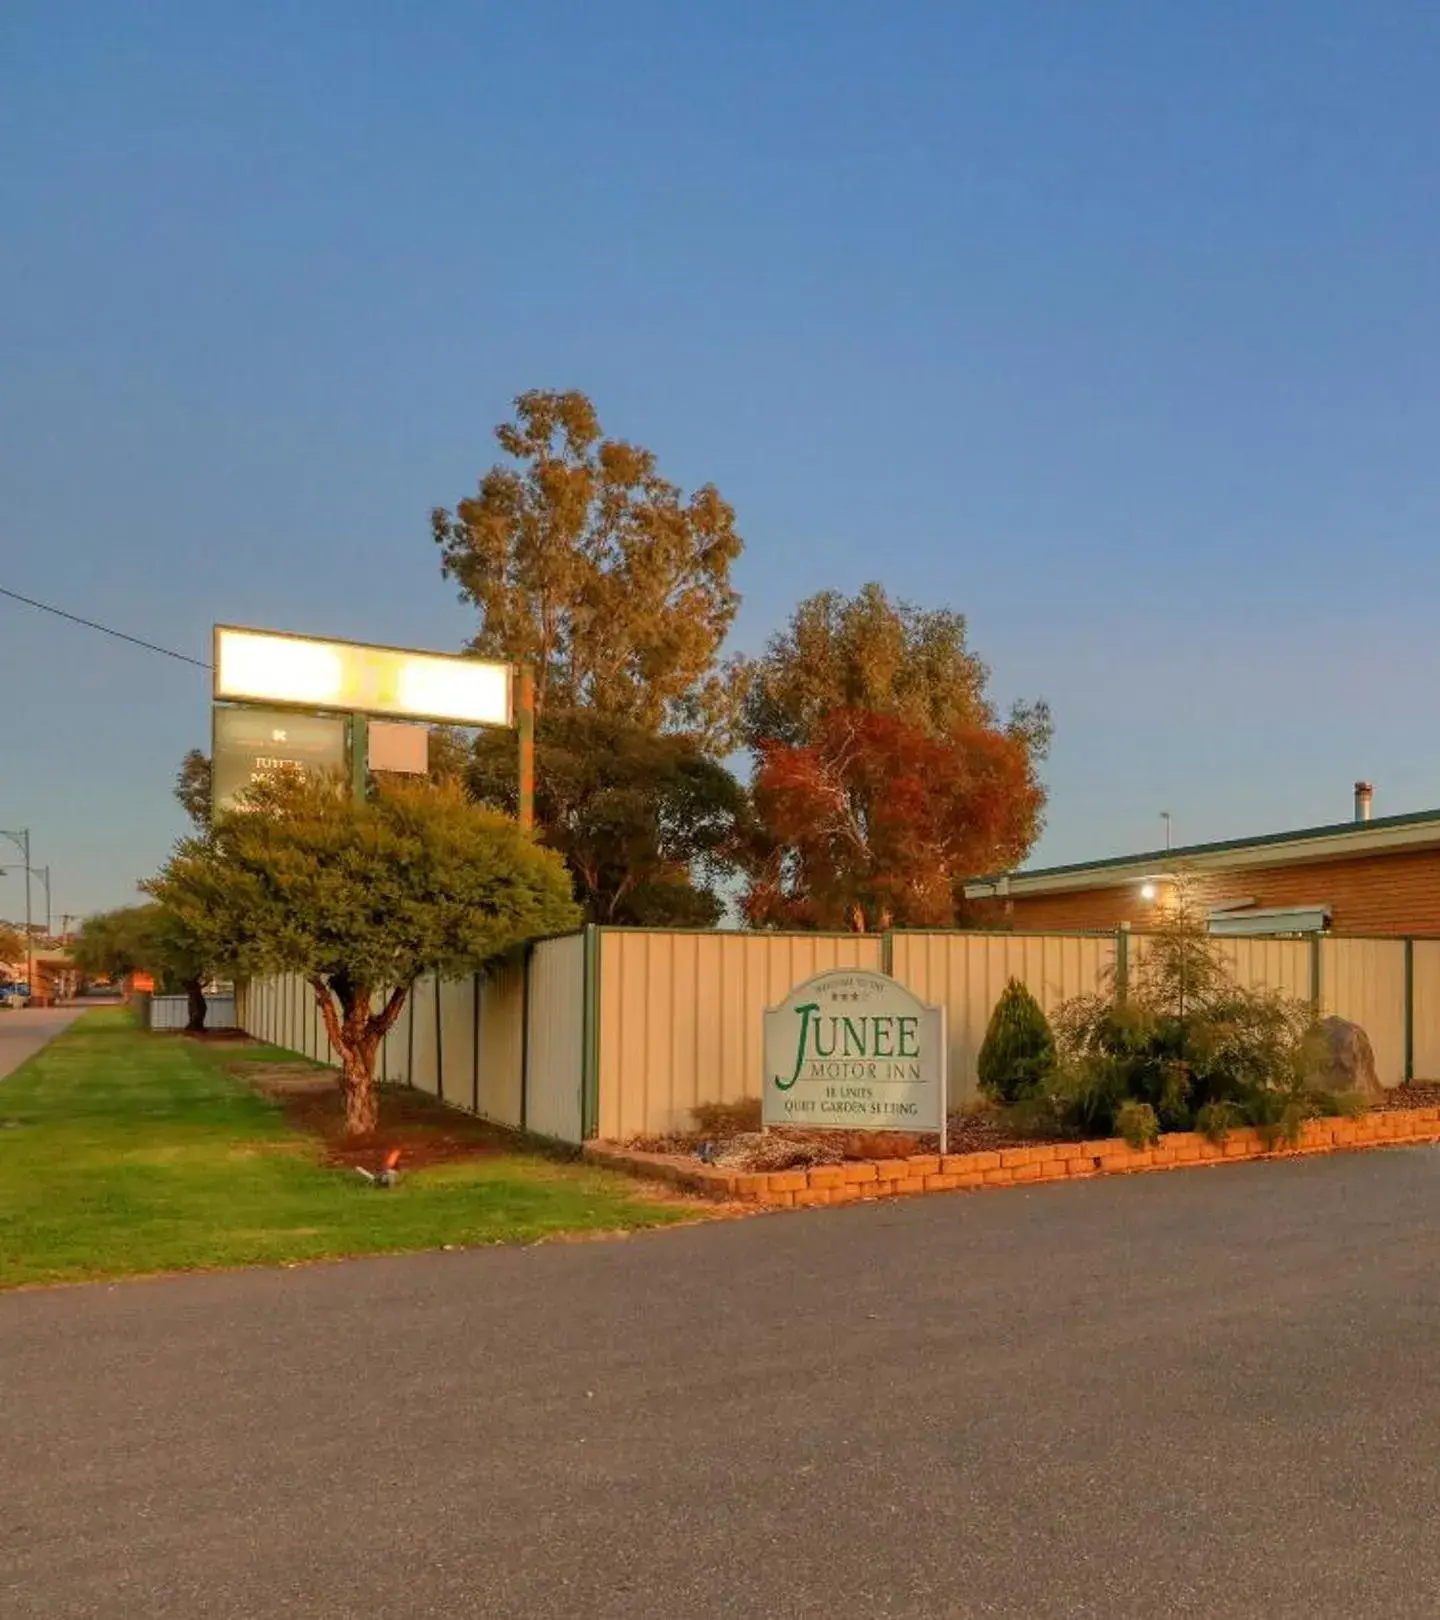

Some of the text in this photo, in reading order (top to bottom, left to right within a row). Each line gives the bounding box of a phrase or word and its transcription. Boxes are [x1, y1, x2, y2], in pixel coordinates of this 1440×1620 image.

[775, 1003, 920, 1090] JUNEE
[810, 1062, 921, 1080] MOTOR INN
[840, 1086, 873, 1098] UNITS
[784, 1099, 918, 1116] QUIET GARDEN SETTING
